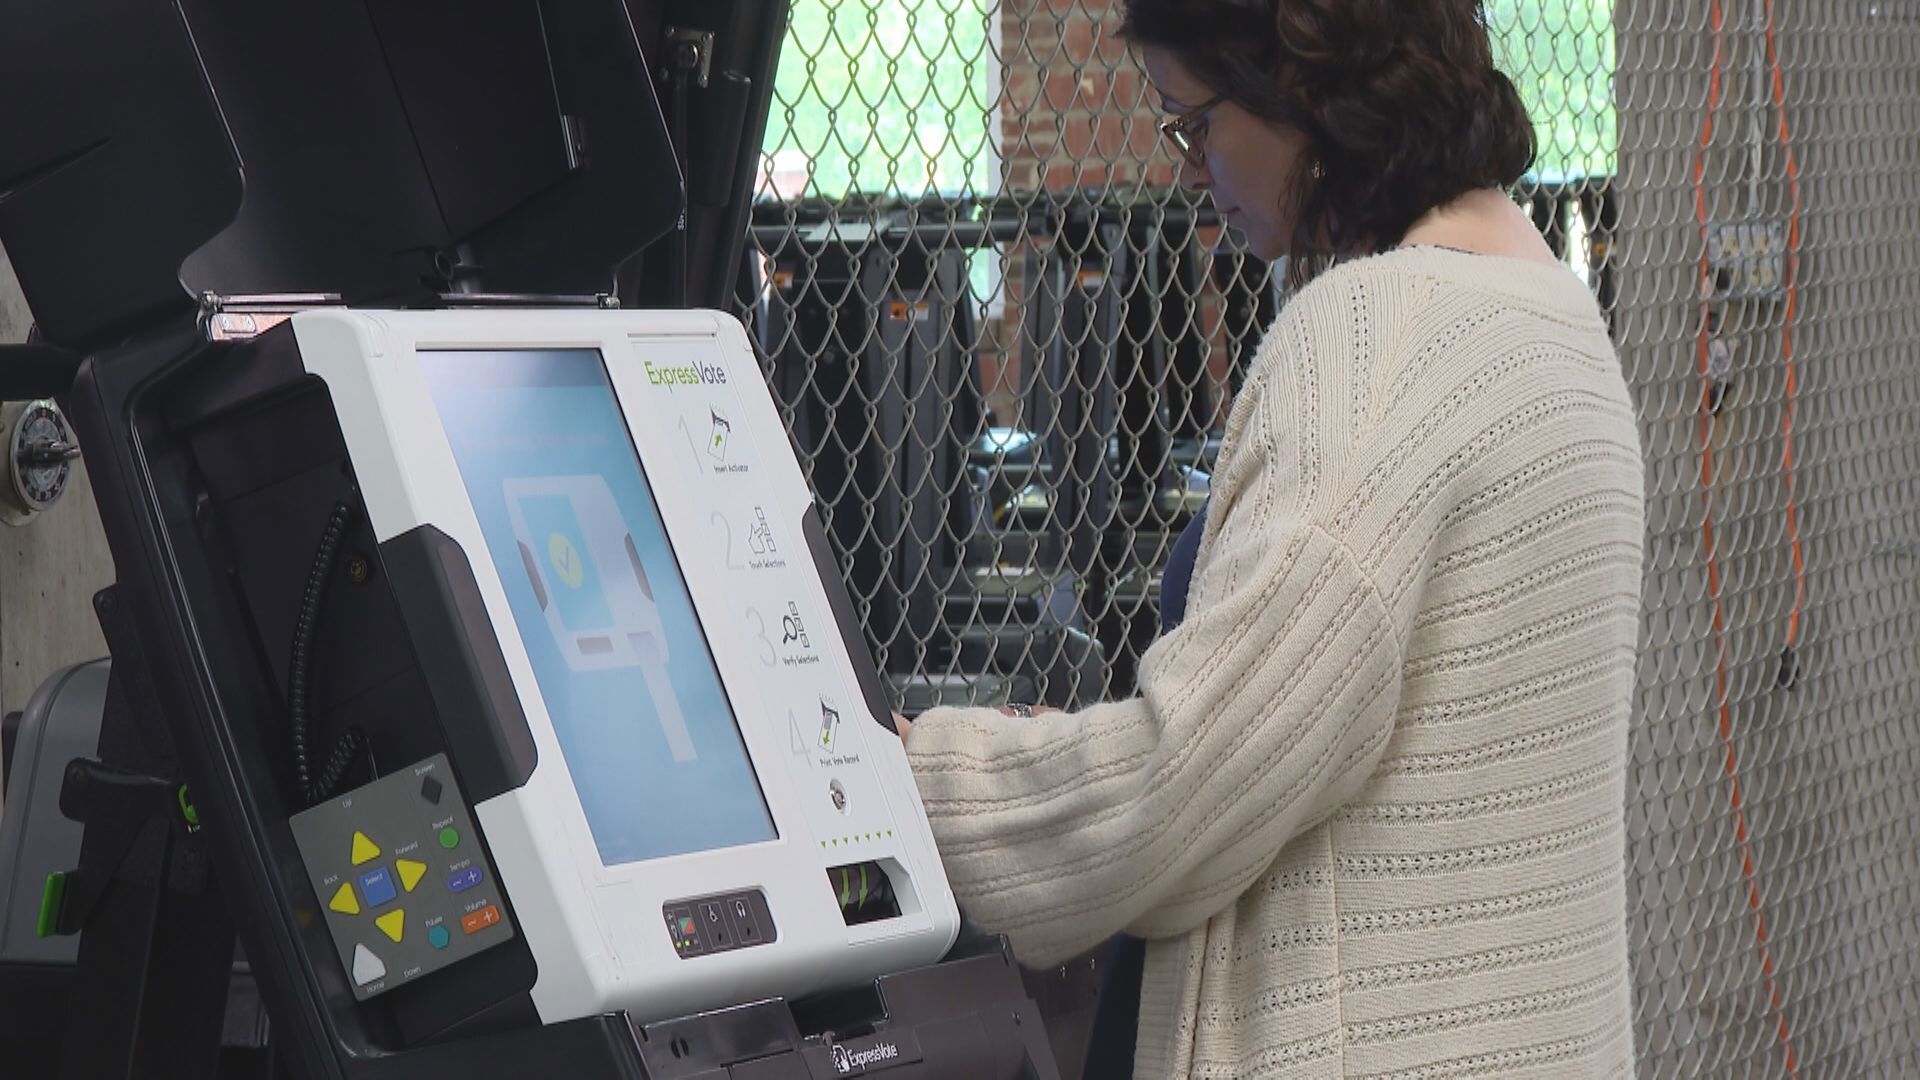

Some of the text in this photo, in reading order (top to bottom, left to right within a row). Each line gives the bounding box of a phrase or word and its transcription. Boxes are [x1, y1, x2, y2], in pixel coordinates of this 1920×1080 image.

[643, 360, 727, 394] ExpressVote
[711, 511, 744, 570] 2
[745, 606, 777, 668] 3
[788, 709, 813, 768] 4
[342, 799, 353, 809] Up
[449, 859, 471, 872] Tempo
[464, 899, 487, 912] Volume
[403, 966, 422, 978] Down
[847, 1042, 898, 1071] ExpressVote
